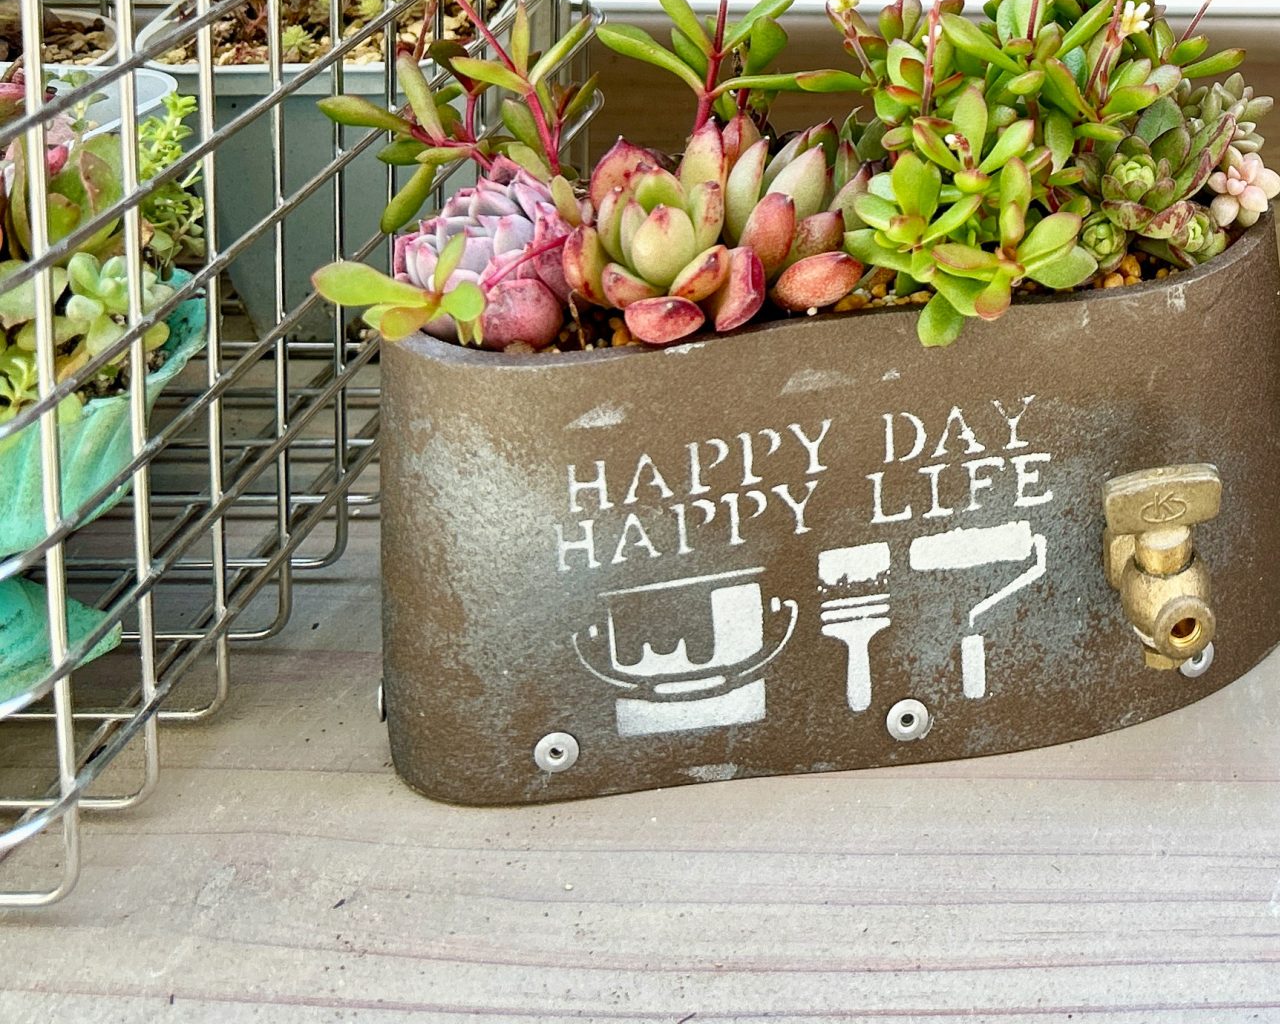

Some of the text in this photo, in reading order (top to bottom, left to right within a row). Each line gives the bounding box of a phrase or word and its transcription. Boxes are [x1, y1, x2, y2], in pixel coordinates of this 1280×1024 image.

[555, 452, 1054, 573] HAPPY LIFE
[566, 394, 1037, 513] HAPPY DAY
